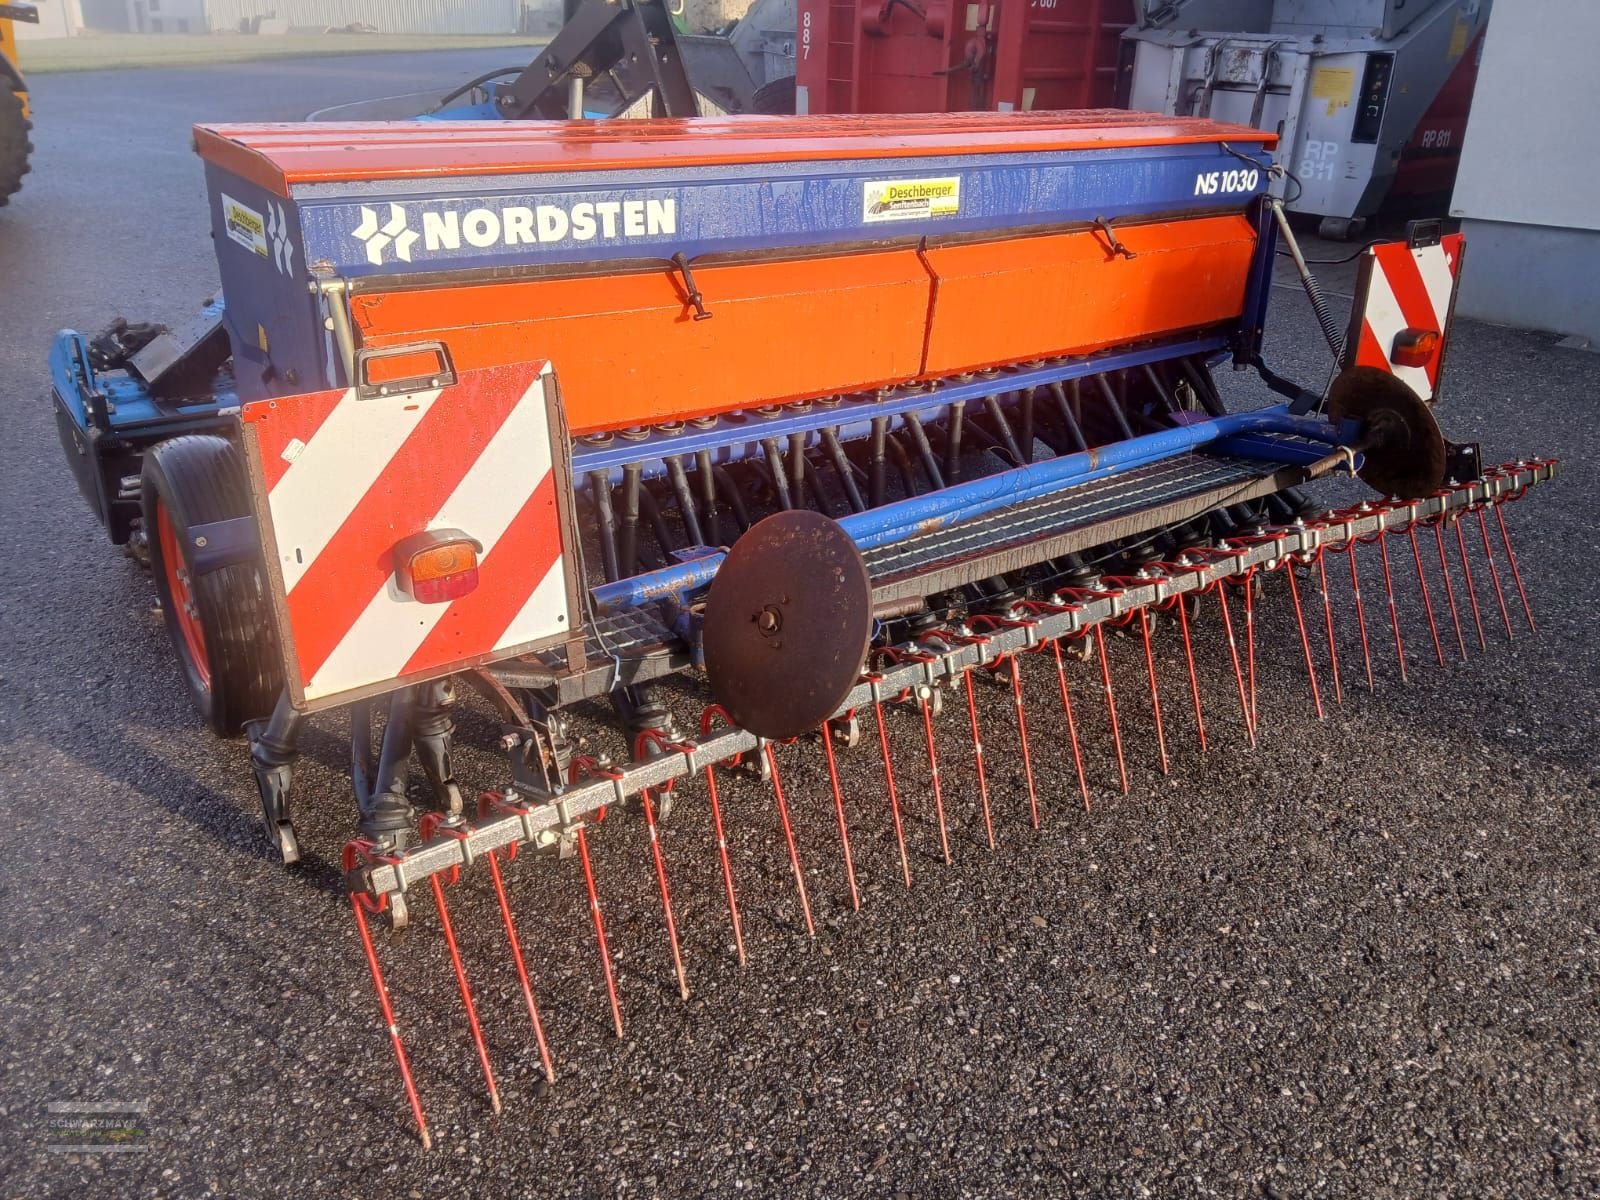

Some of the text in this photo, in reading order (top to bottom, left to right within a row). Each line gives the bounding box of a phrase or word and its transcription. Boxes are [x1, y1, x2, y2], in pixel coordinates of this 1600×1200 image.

[802, 11, 811, 60] 887
[1422, 128, 1452, 148] RP 811
[1303, 140, 1338, 160] RP
[1300, 160, 1335, 180] 811
[889, 184, 952, 199] Deschberger
[1194, 169, 1259, 196] NS 1030
[422, 199, 676, 250] NORDSTEN
